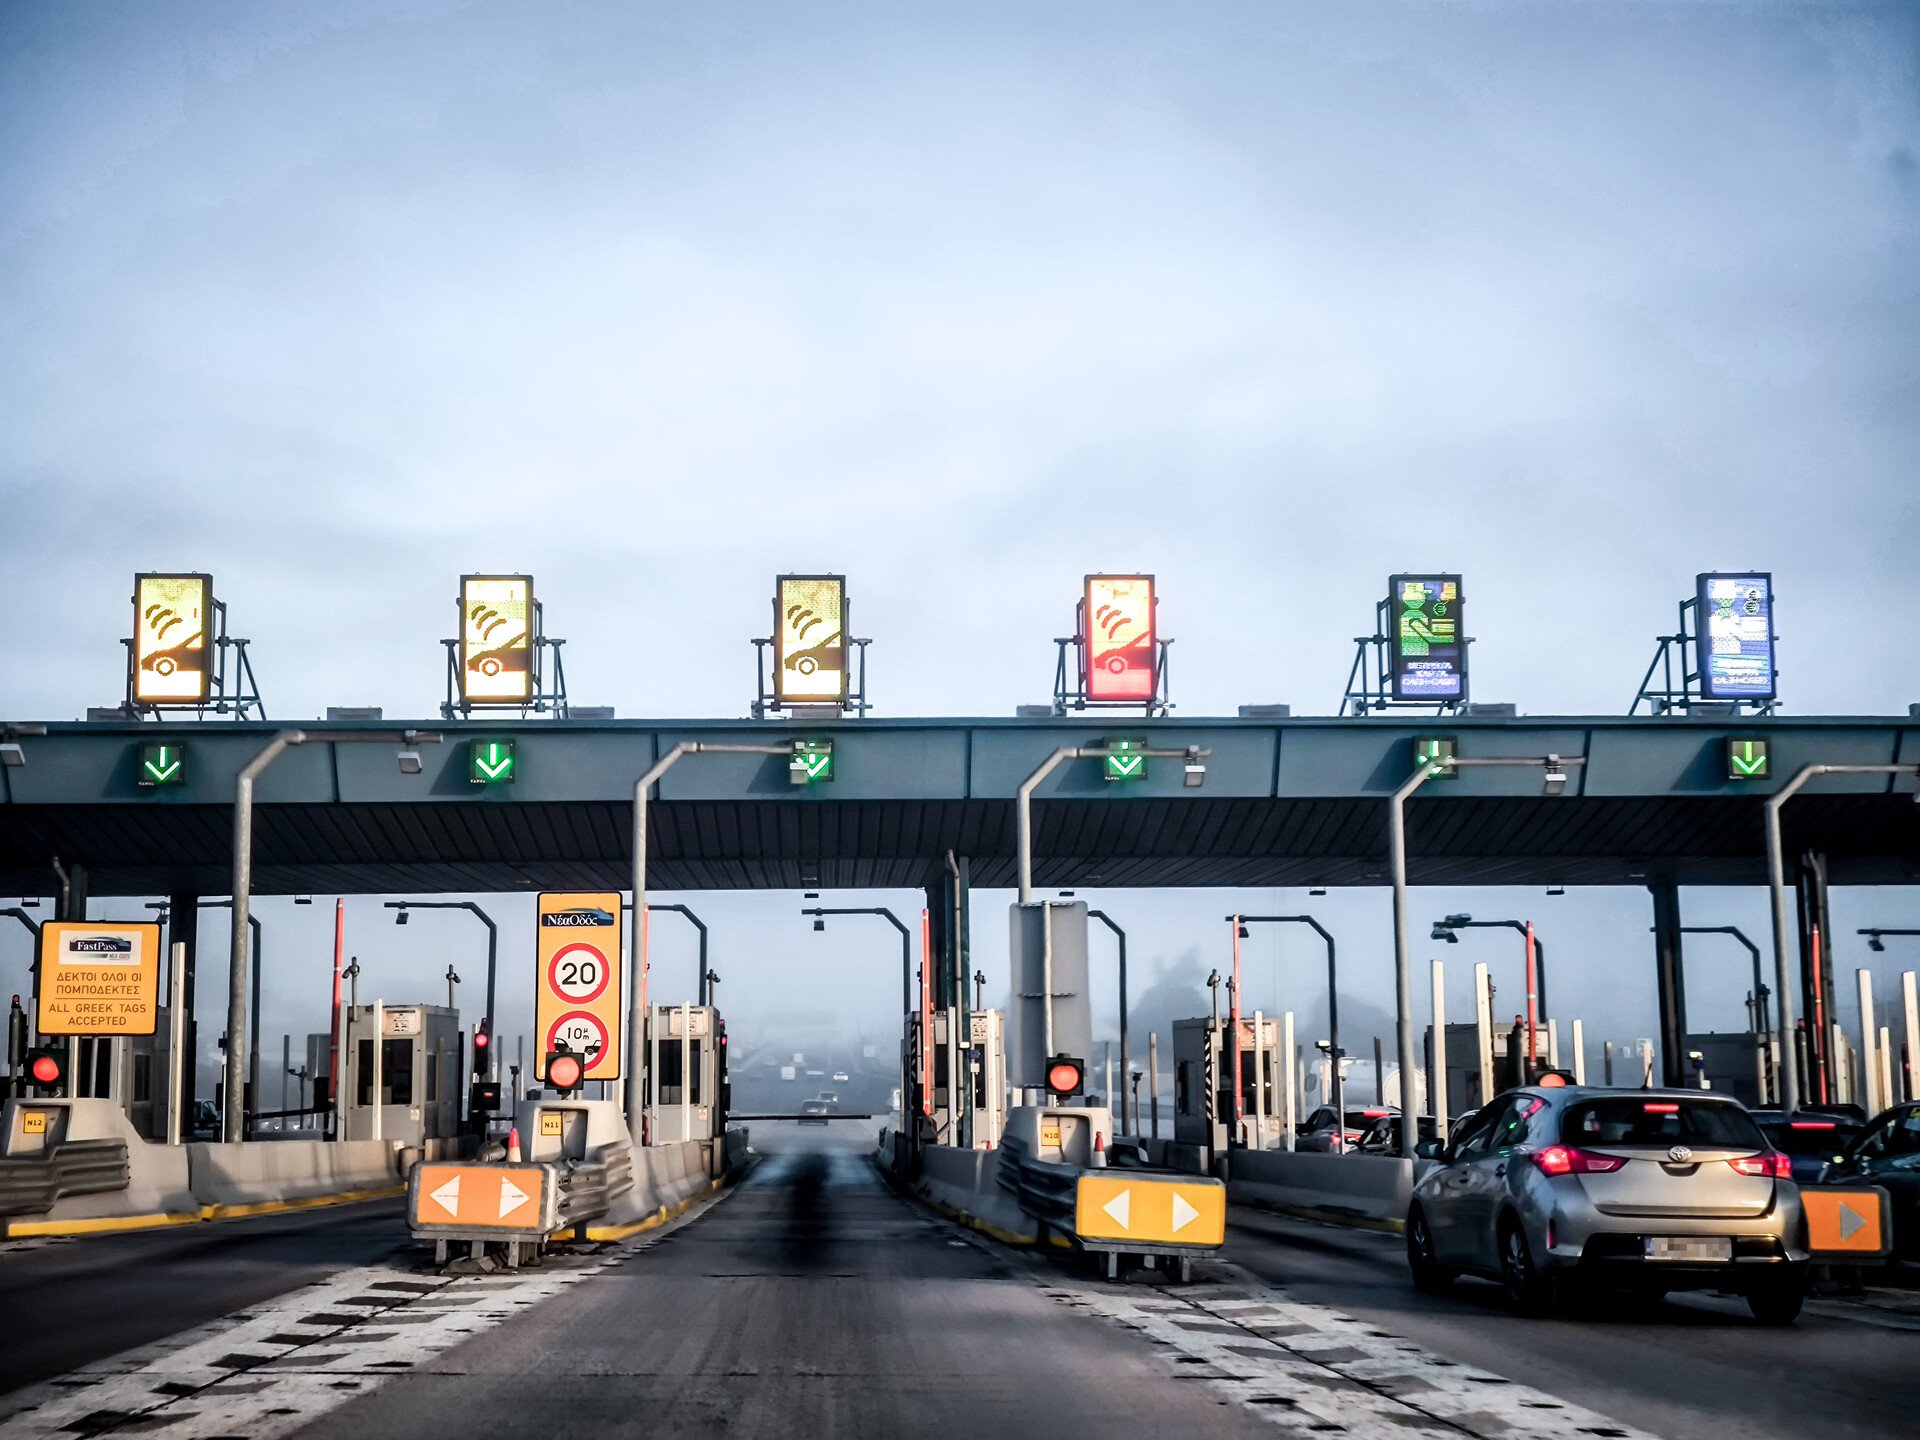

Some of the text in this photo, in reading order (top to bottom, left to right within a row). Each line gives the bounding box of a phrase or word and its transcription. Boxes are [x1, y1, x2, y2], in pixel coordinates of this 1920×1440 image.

[76, 941, 118, 951] FastPass
[57, 972, 142, 982] ΔΕΚΤΟΙ ΟΛΟΙ ΟΙ
[562, 962, 596, 985] 20
[56, 985, 140, 995] ΠΟΜΠΟΔΕΚΤΕΣ
[49, 1003, 147, 1013] ALL GREEK TAGS
[68, 1016, 127, 1026] ACCEPTED
[567, 1027, 582, 1039] 10
